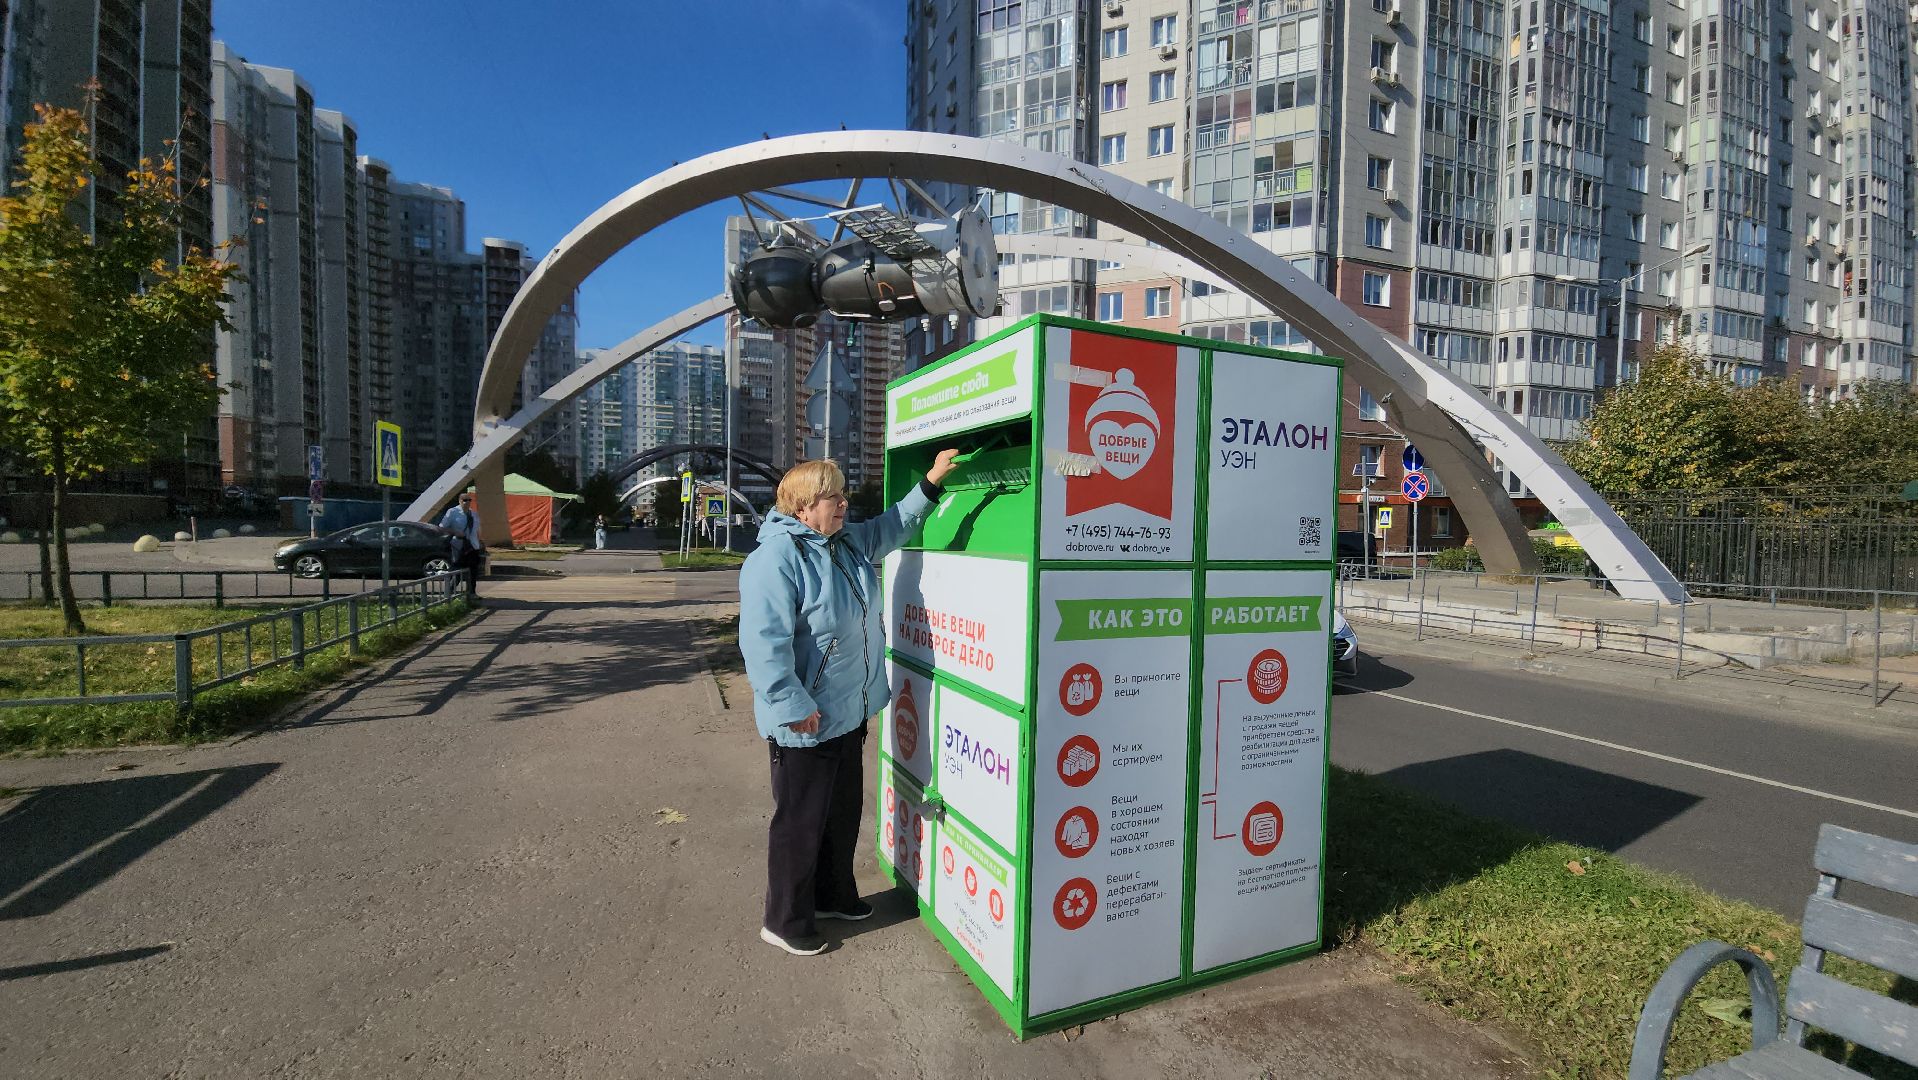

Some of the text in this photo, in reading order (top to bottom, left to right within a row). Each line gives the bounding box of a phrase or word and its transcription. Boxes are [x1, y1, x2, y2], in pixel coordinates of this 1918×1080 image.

[912, 371, 989, 413] Положите сюда
[1098, 433, 1147, 449] ДОБРЫЕ
[1221, 417, 1328, 450] ЭТАЛОН
[1105, 450, 1140, 465] ВЕЩИ
[1220, 450, 1256, 470] УЭН
[1066, 523, 1171, 540] +7 (495) 744-76-93
[1066, 542, 1114, 552] dobrove.ru
[1132, 544, 1171, 554] dobro_ve
[904, 603, 985, 644] ДОБРЫЕ ВЕЩИ
[1088, 606, 1310, 630] КАК ЭТО РАБОТАЕТ
[899, 622, 994, 672] НА ДОБРОЕ ДЕЛО
[1114, 672, 1181, 684] Вы приносите
[1114, 688, 1140, 698] вещи
[1302, 736, 1320, 744] детей
[945, 724, 1010, 786] ЭТАЛОН
[1112, 744, 1143, 754] Мы их
[1112, 754, 1163, 767] сортируем
[1111, 794, 1138, 805] Вещи
[1111, 804, 1163, 818] в хорошем
[1110, 816, 1160, 832] состоянии
[1110, 831, 1150, 844] находят
[1110, 840, 1175, 857] новых хозяев
[1106, 870, 1141, 884] Вещи с
[1106, 880, 1159, 898] дефектами
[1106, 892, 1168, 910] перерабаты-
[1106, 908, 1140, 922] ваются
